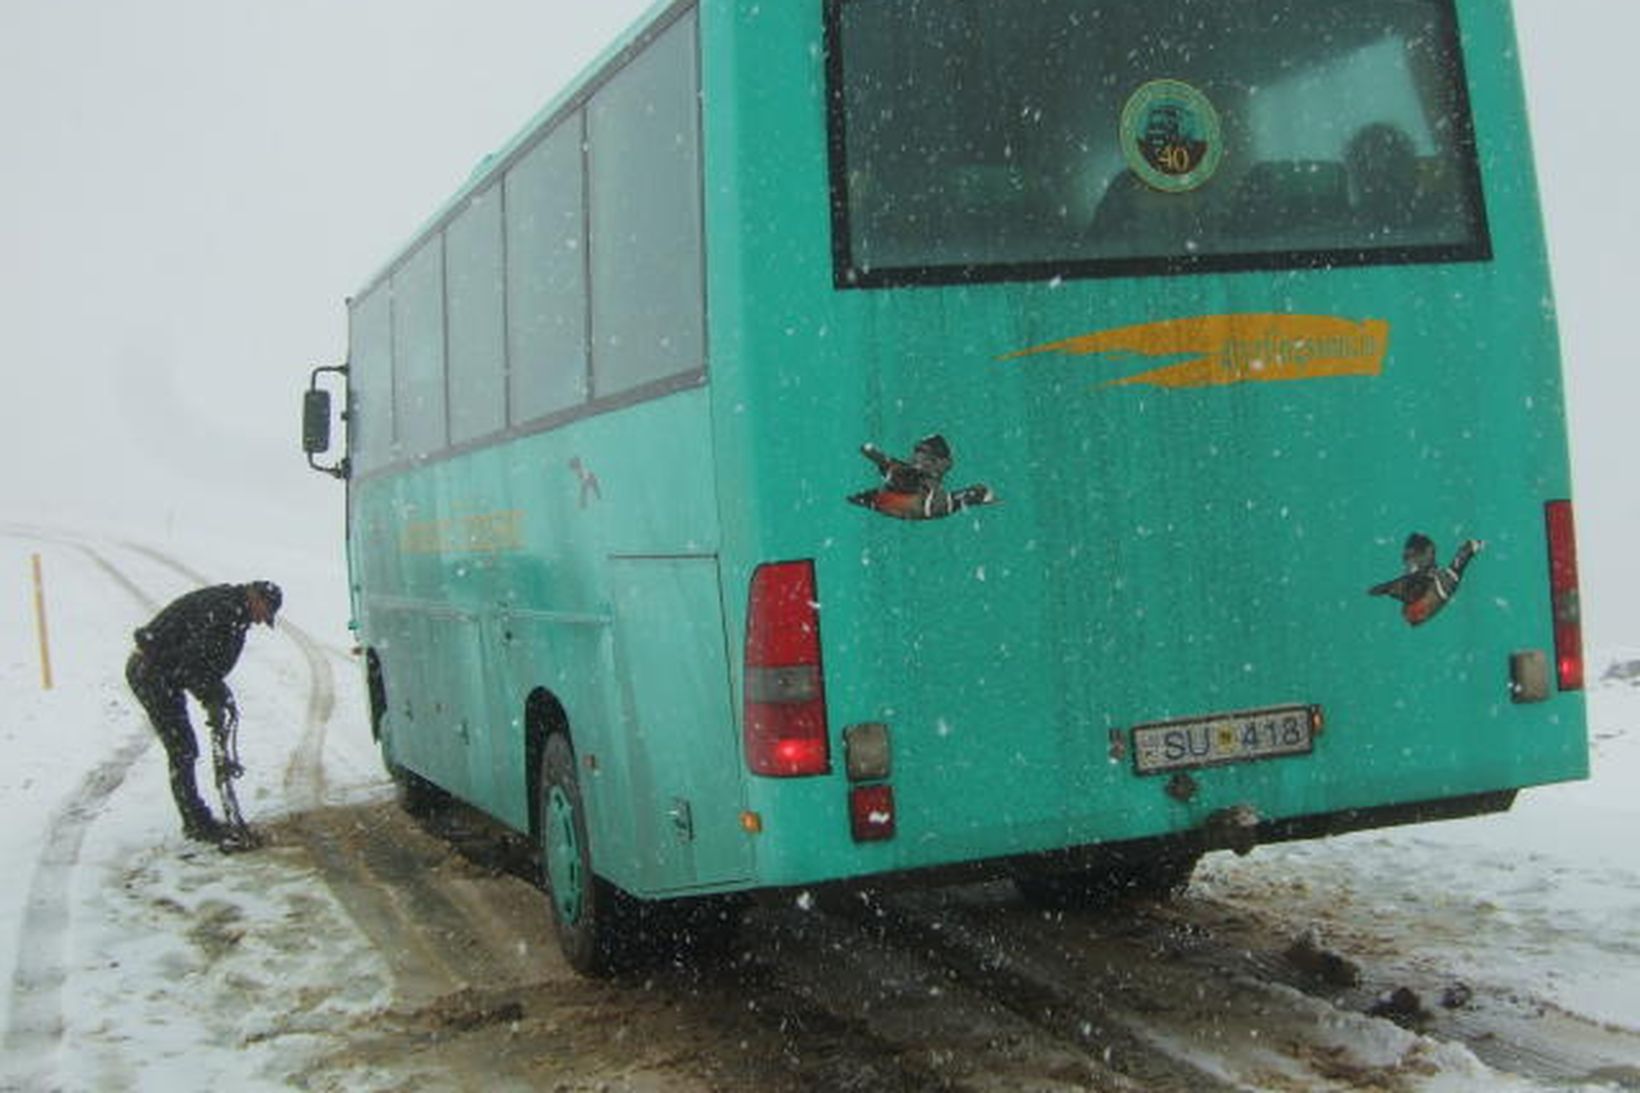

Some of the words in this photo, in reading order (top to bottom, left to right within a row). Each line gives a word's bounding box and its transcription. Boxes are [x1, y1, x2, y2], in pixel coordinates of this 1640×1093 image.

[1157, 145, 1190, 172] 40
[1164, 726, 1211, 761] SU
[1241, 716, 1301, 747] 418
